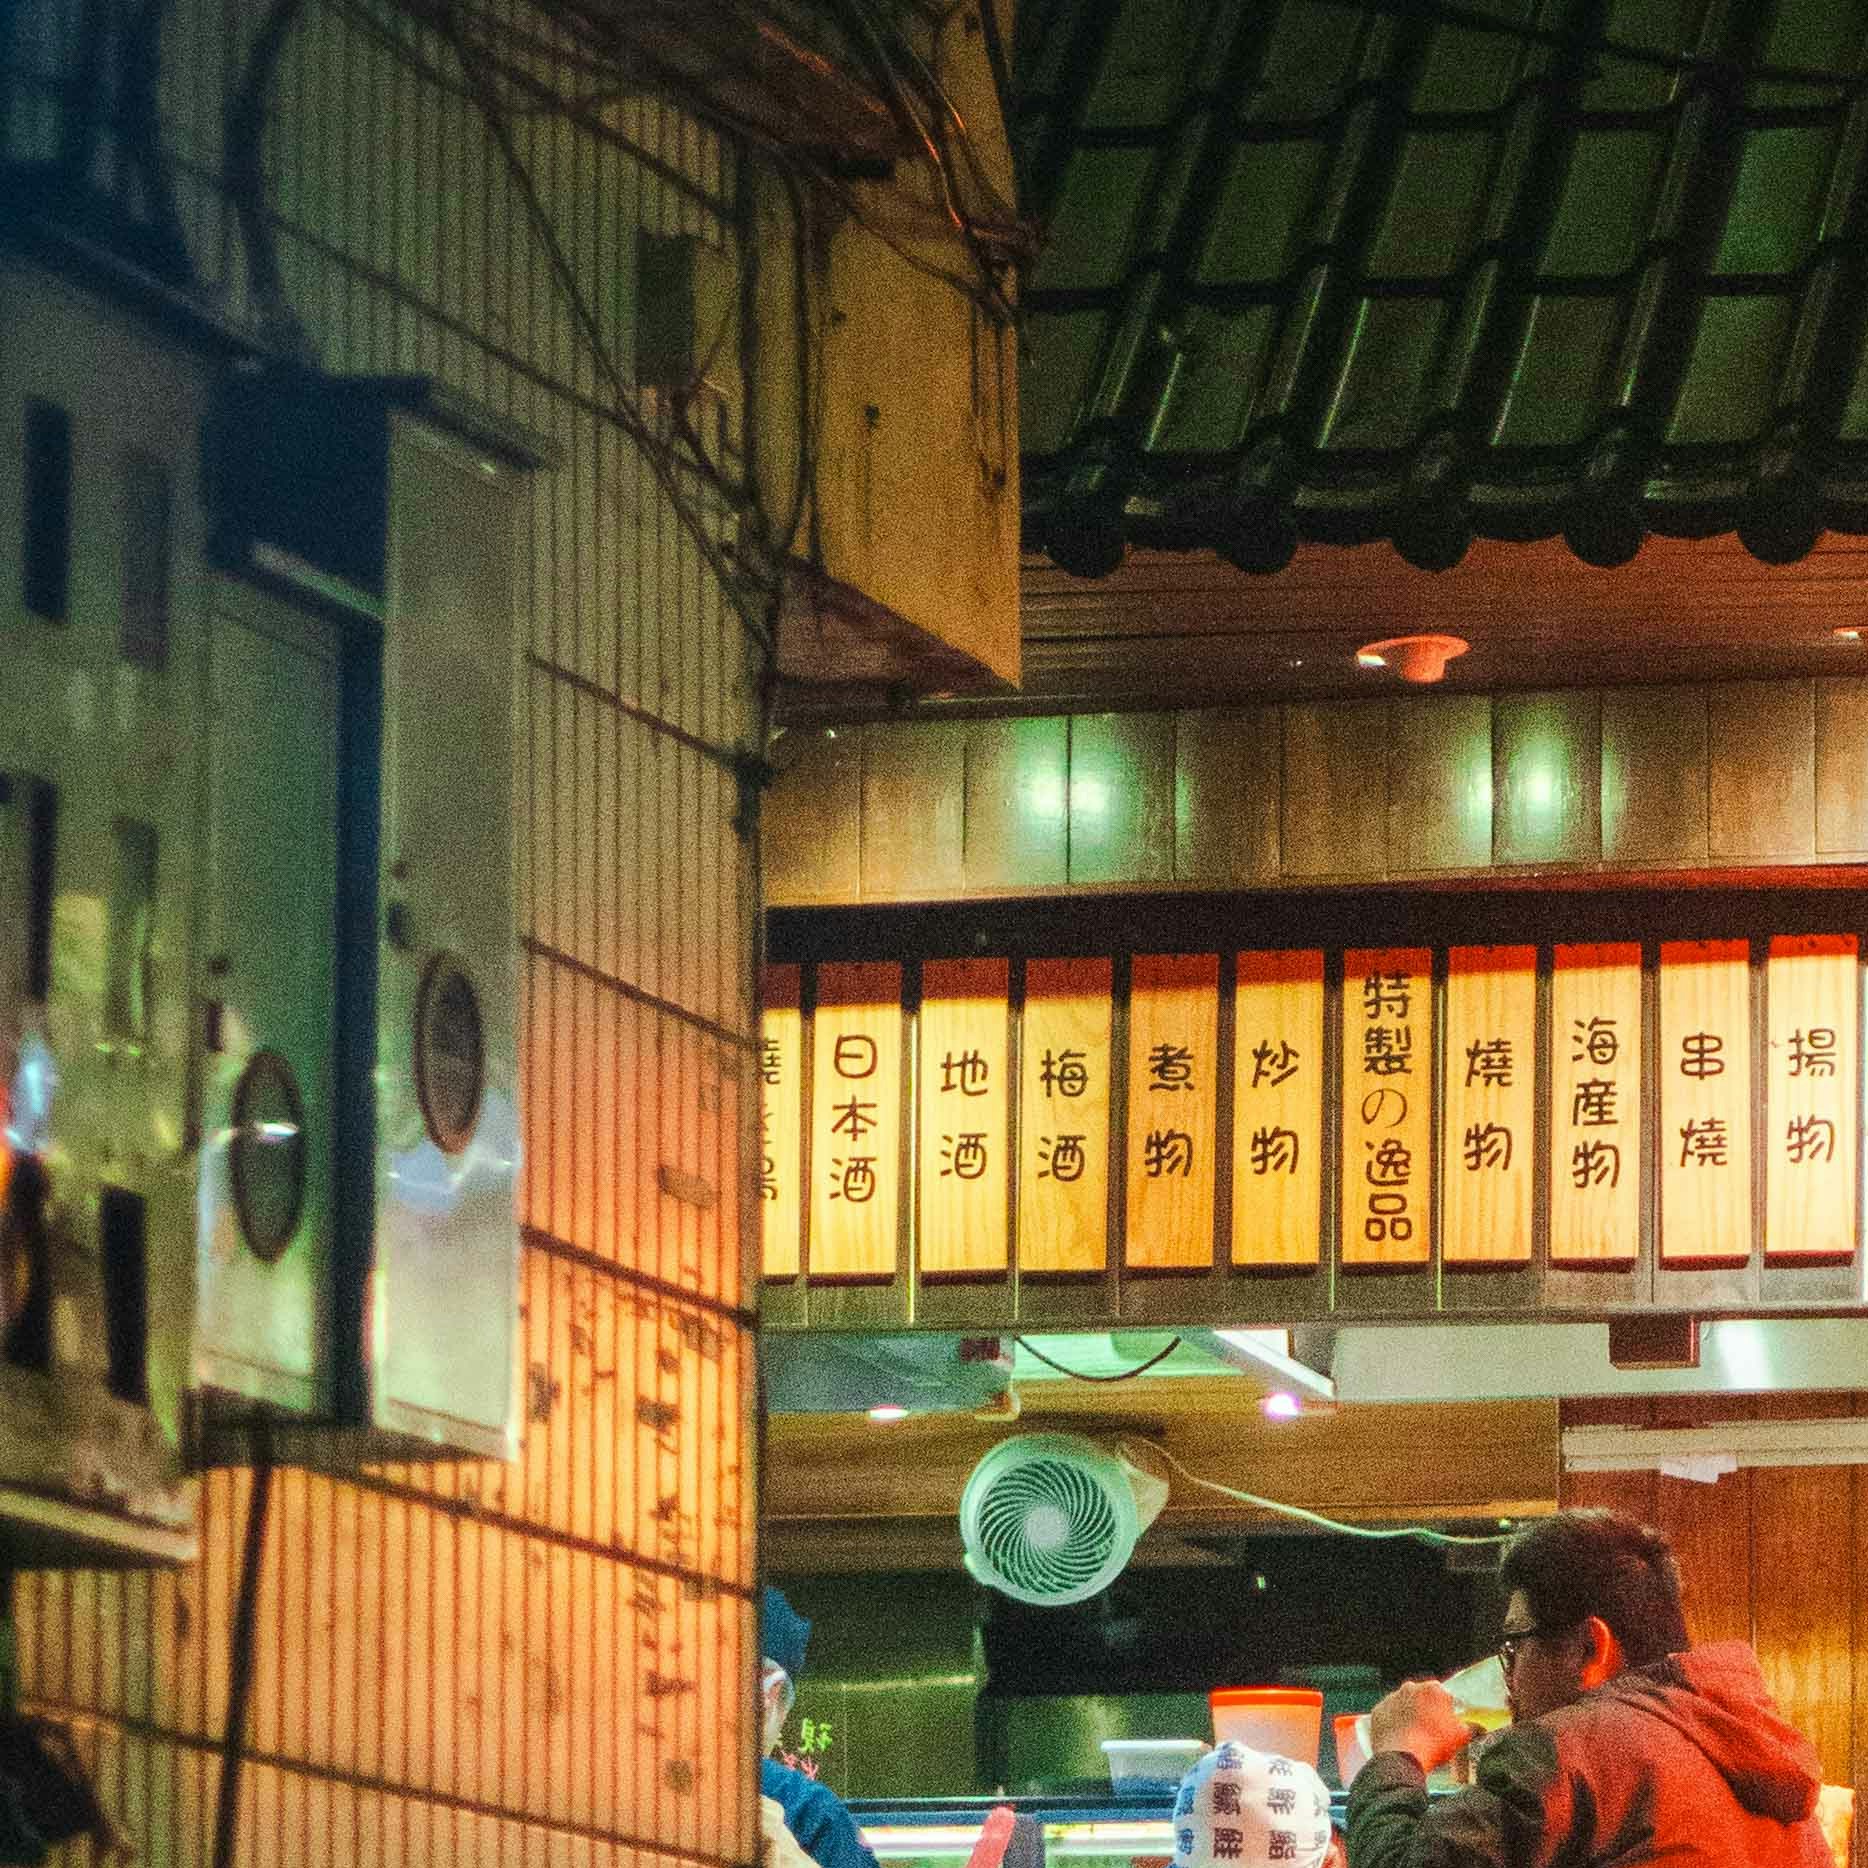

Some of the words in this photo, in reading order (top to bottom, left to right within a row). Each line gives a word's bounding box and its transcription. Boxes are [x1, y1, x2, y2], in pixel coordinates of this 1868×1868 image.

[829, 1034, 878, 1203] 日本酒
[940, 1049, 988, 1180] 地酒
[1038, 1049, 1089, 1183] 梅酒
[1144, 1043, 1194, 1178] 煮物
[1251, 1040, 1299, 1175] 炒物
[1571, 1017, 1620, 1189] 海産物
[1786, 1028, 1836, 1163] 揚物
